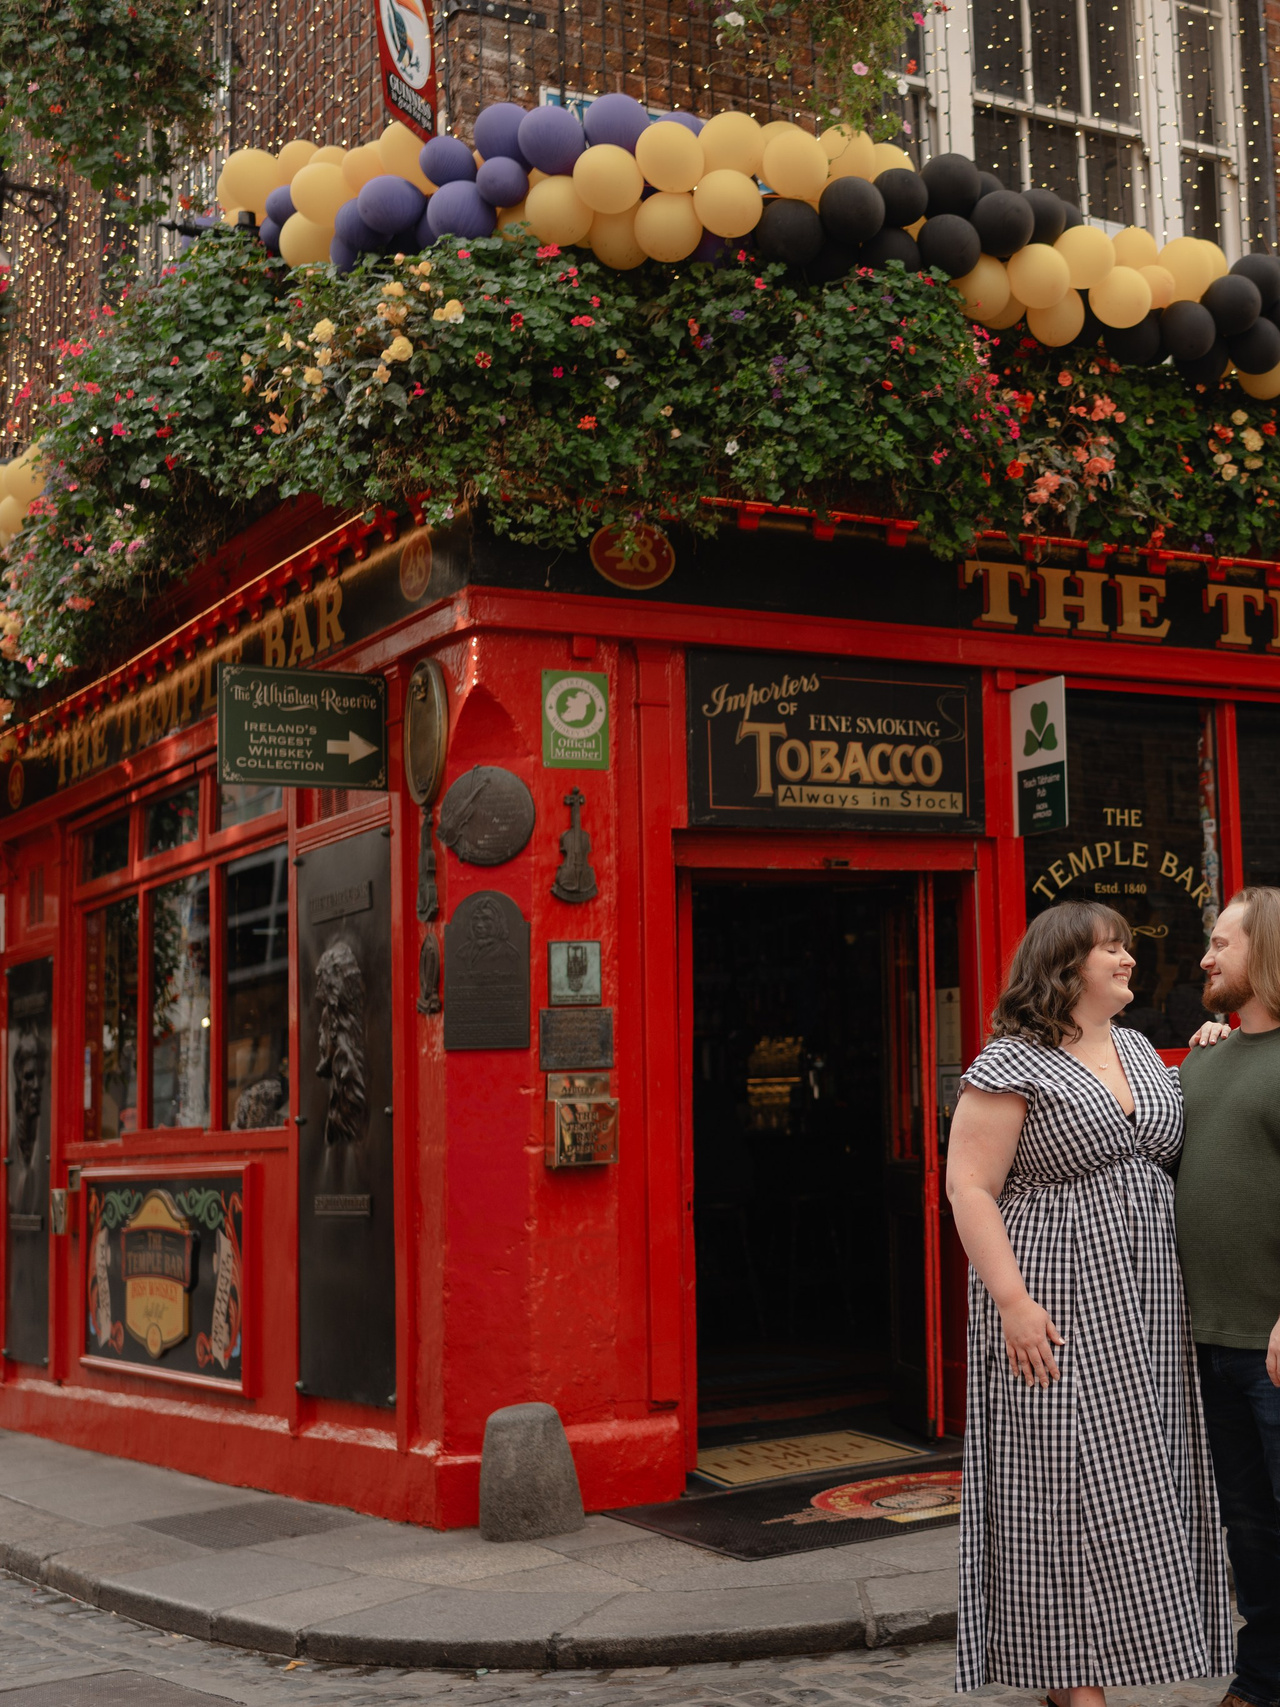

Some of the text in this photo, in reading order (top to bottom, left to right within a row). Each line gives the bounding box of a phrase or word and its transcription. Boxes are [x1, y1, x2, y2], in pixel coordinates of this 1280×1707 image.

[390, 73, 432, 120] GUINNESS
[957, 560, 1172, 644] THE
[262, 584, 345, 669] BAR
[230, 680, 377, 715] The Whiskey Reserve
[702, 672, 820, 721] Importers
[777, 702, 798, 716] OF
[808, 714, 941, 738] FINE SMOKING
[248, 745, 313, 759] WHISKEY
[250, 734, 312, 747] LARGEST
[558, 737, 596, 749] Official
[236, 756, 325, 771] COLLECTION
[555, 748, 599, 759] Member
[735, 721, 944, 798] TOBACCO
[781, 786, 960, 811] Always in Stock
[1102, 808, 1143, 827] THE
[1031, 840, 1213, 909] TEMPLE BAR
[1094, 882, 1147, 894] Estd. 1840
[147, 1231, 163, 1250] THE
[127, 1250, 184, 1280] TEMPLE BAR
